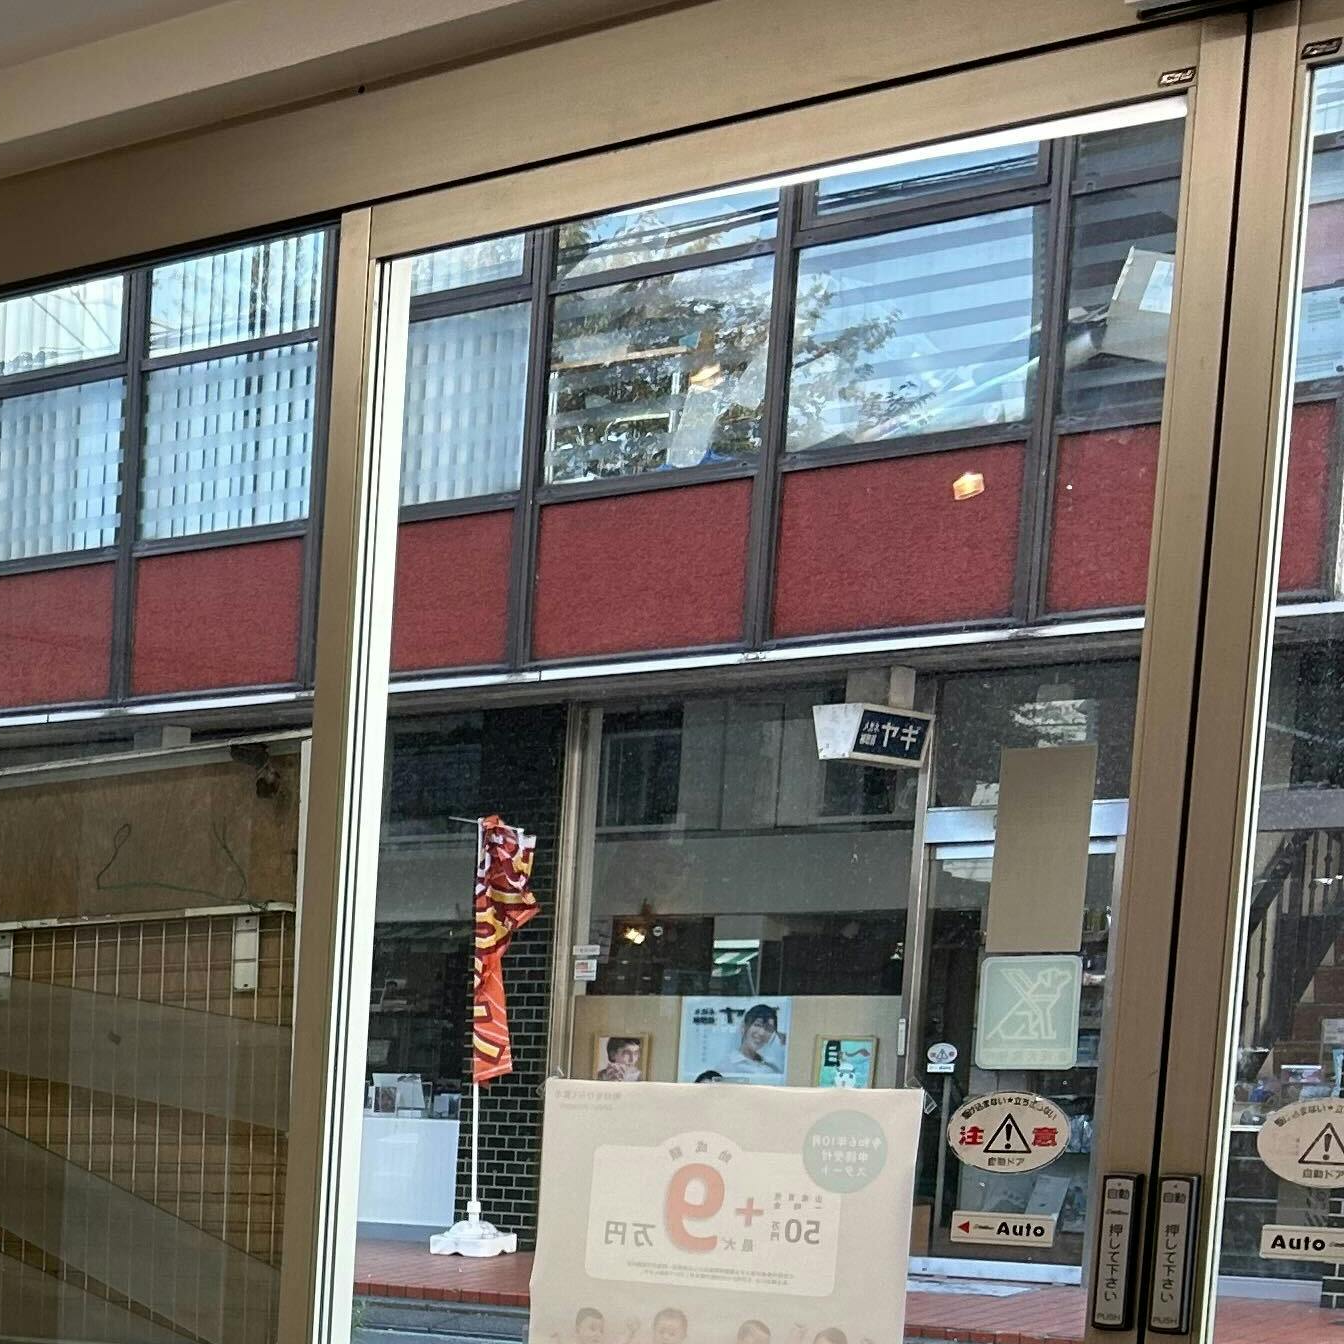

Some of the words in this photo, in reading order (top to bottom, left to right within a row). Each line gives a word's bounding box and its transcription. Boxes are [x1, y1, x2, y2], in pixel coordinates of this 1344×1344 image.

[881, 722, 922, 751] ヤギ
[1107, 1189, 1130, 1200] 自動
[1163, 1192, 1187, 1203] 自動
[996, 1221, 1045, 1237] Auto
[1271, 1234, 1326, 1251] Auto
[1104, 1223, 1123, 1302] 押して下さい
[1160, 1224, 1180, 1303] 押して下さい
